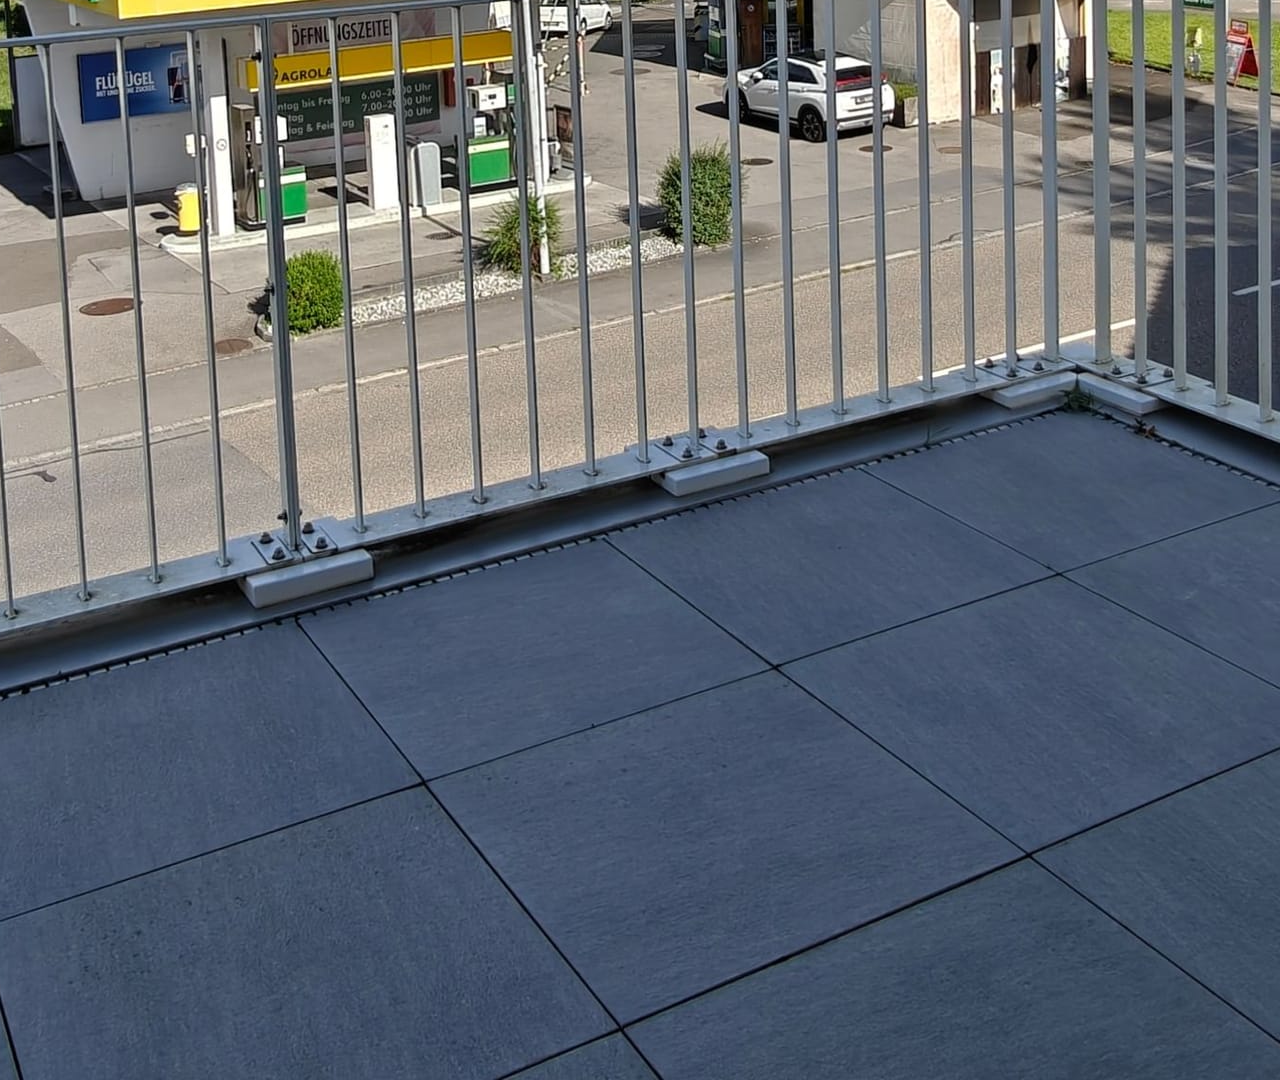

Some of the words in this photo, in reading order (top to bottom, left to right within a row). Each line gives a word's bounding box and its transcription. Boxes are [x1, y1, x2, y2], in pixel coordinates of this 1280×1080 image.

[281, 67, 333, 82] AGROLA
[414, 82, 432, 93] Uhr
[415, 94, 433, 105] Uhr
[416, 106, 434, 117] Uhr
